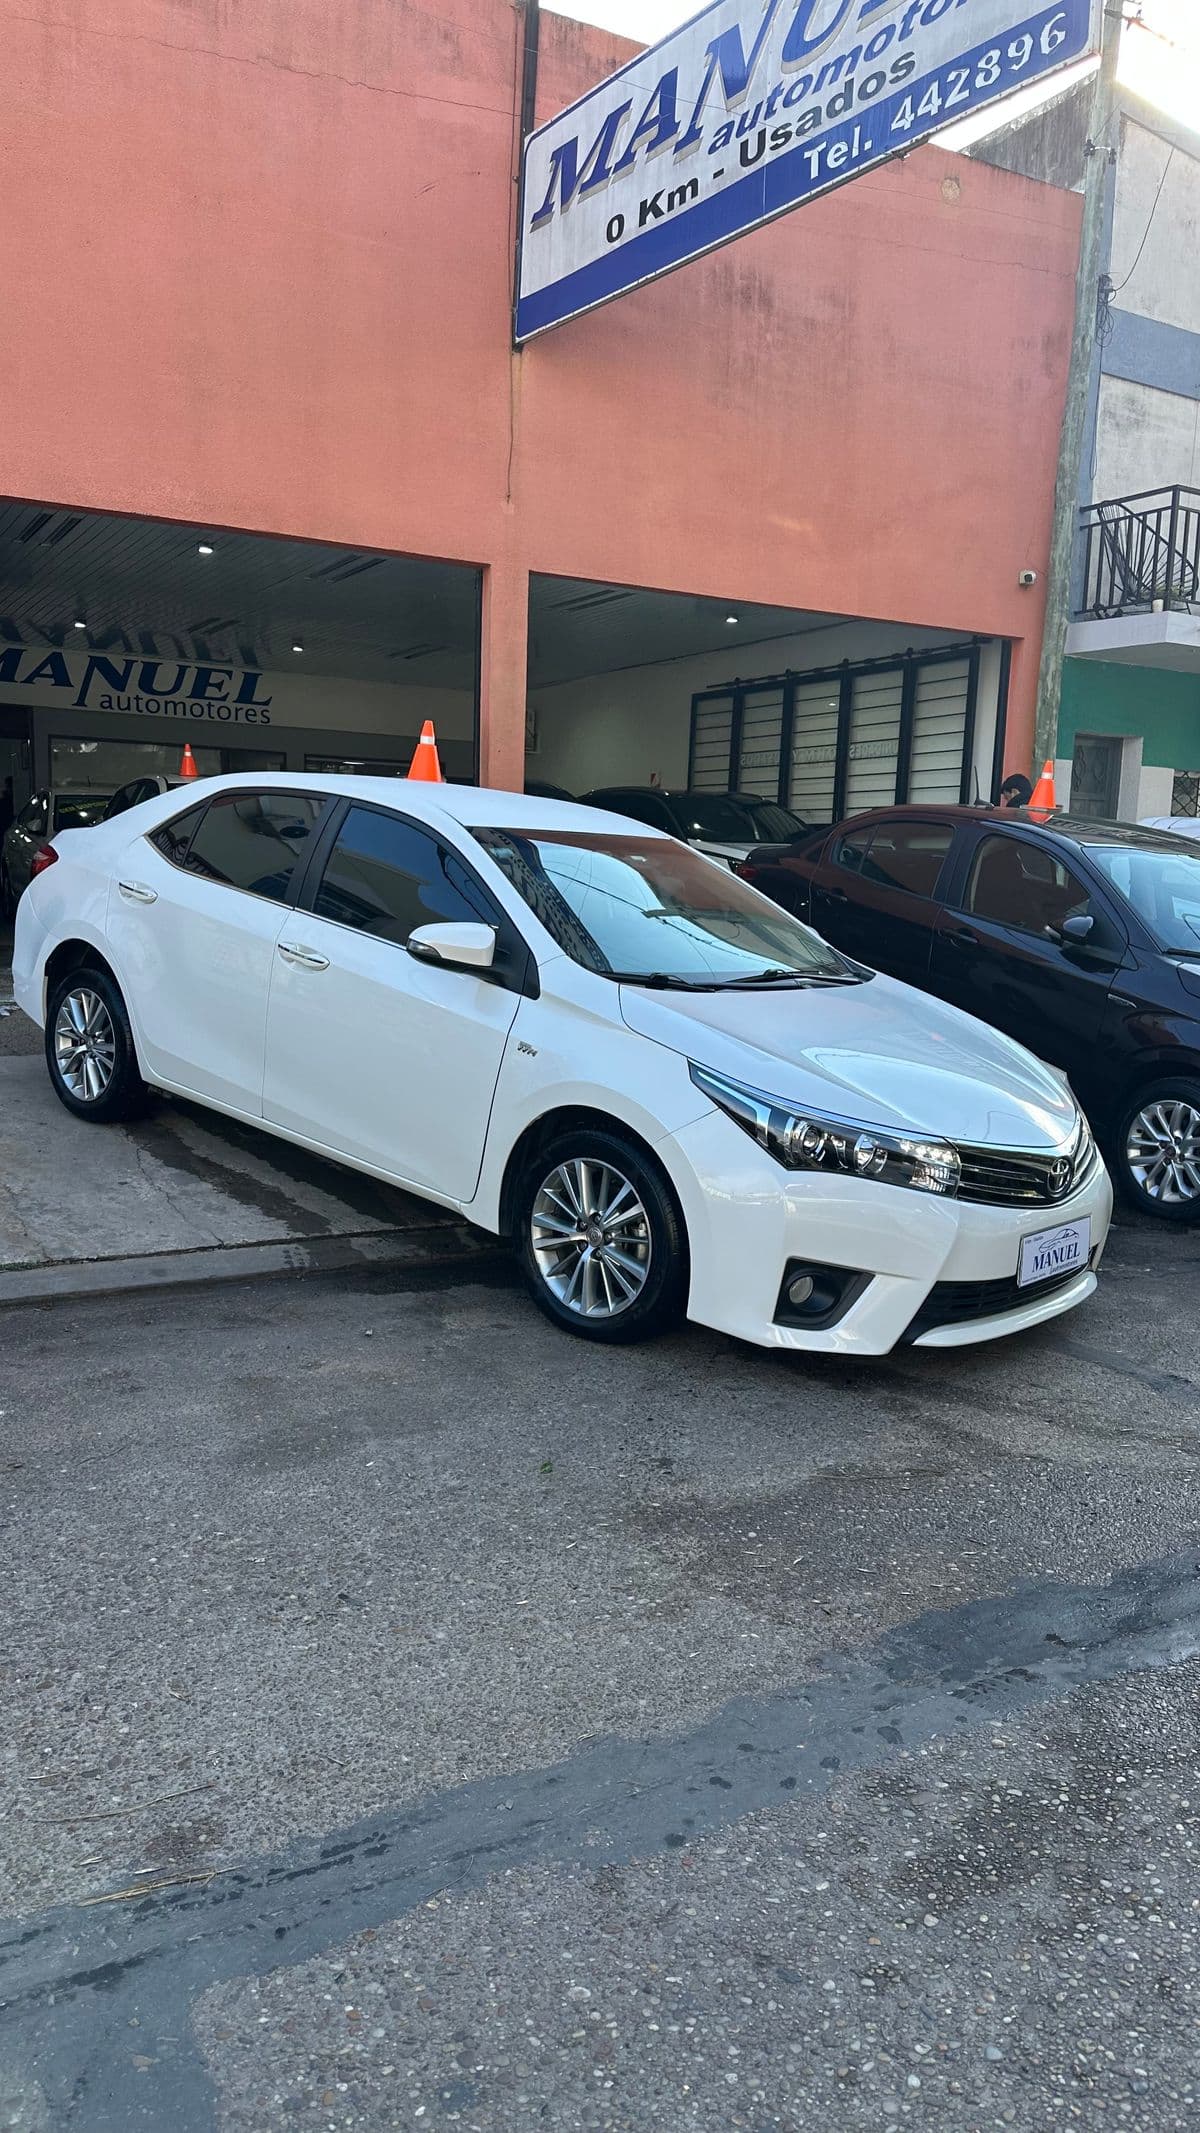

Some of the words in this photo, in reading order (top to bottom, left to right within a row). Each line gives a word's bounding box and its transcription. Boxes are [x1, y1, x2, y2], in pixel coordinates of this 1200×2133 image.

[531, 0, 905, 230] MANU
[638, 177, 699, 227] Km
[739, 51, 916, 169] Usados
[707, 0, 967, 155] automoto
[803, 125, 874, 180] Tel.
[890, 12, 1067, 132] 442896
[100, 693, 271, 725] automotores
[1032, 1242, 1080, 1273] MANUEL
